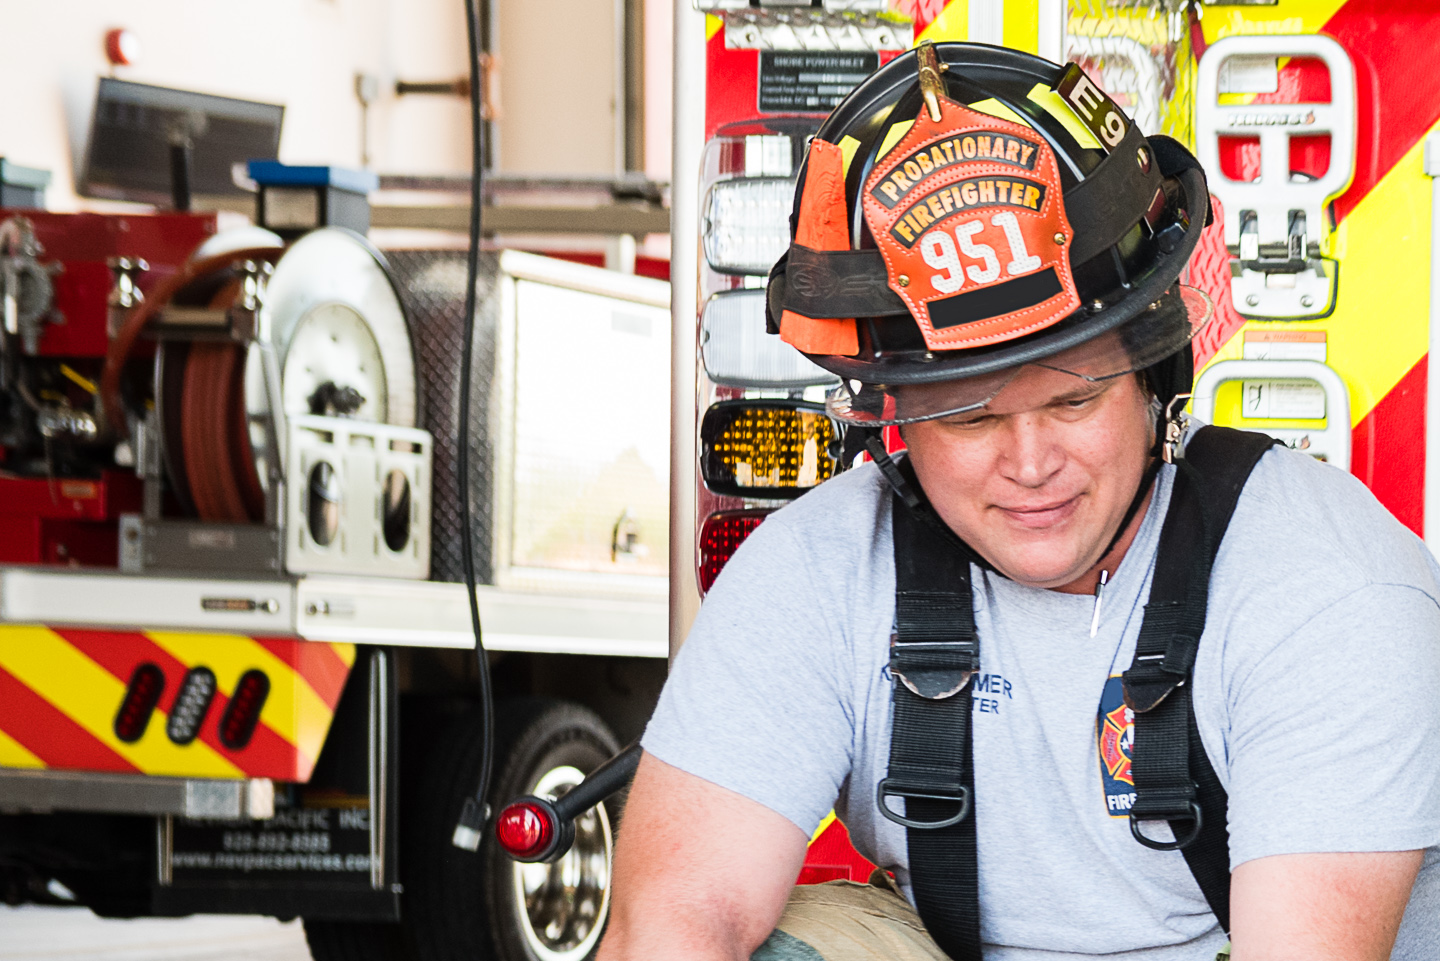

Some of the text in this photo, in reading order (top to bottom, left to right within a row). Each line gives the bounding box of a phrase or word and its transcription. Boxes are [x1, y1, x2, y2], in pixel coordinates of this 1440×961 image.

[880, 136, 1034, 202] PROBATIONARY
[894, 180, 1041, 242] FIREFIGHTER
[920, 211, 1042, 294] 951
